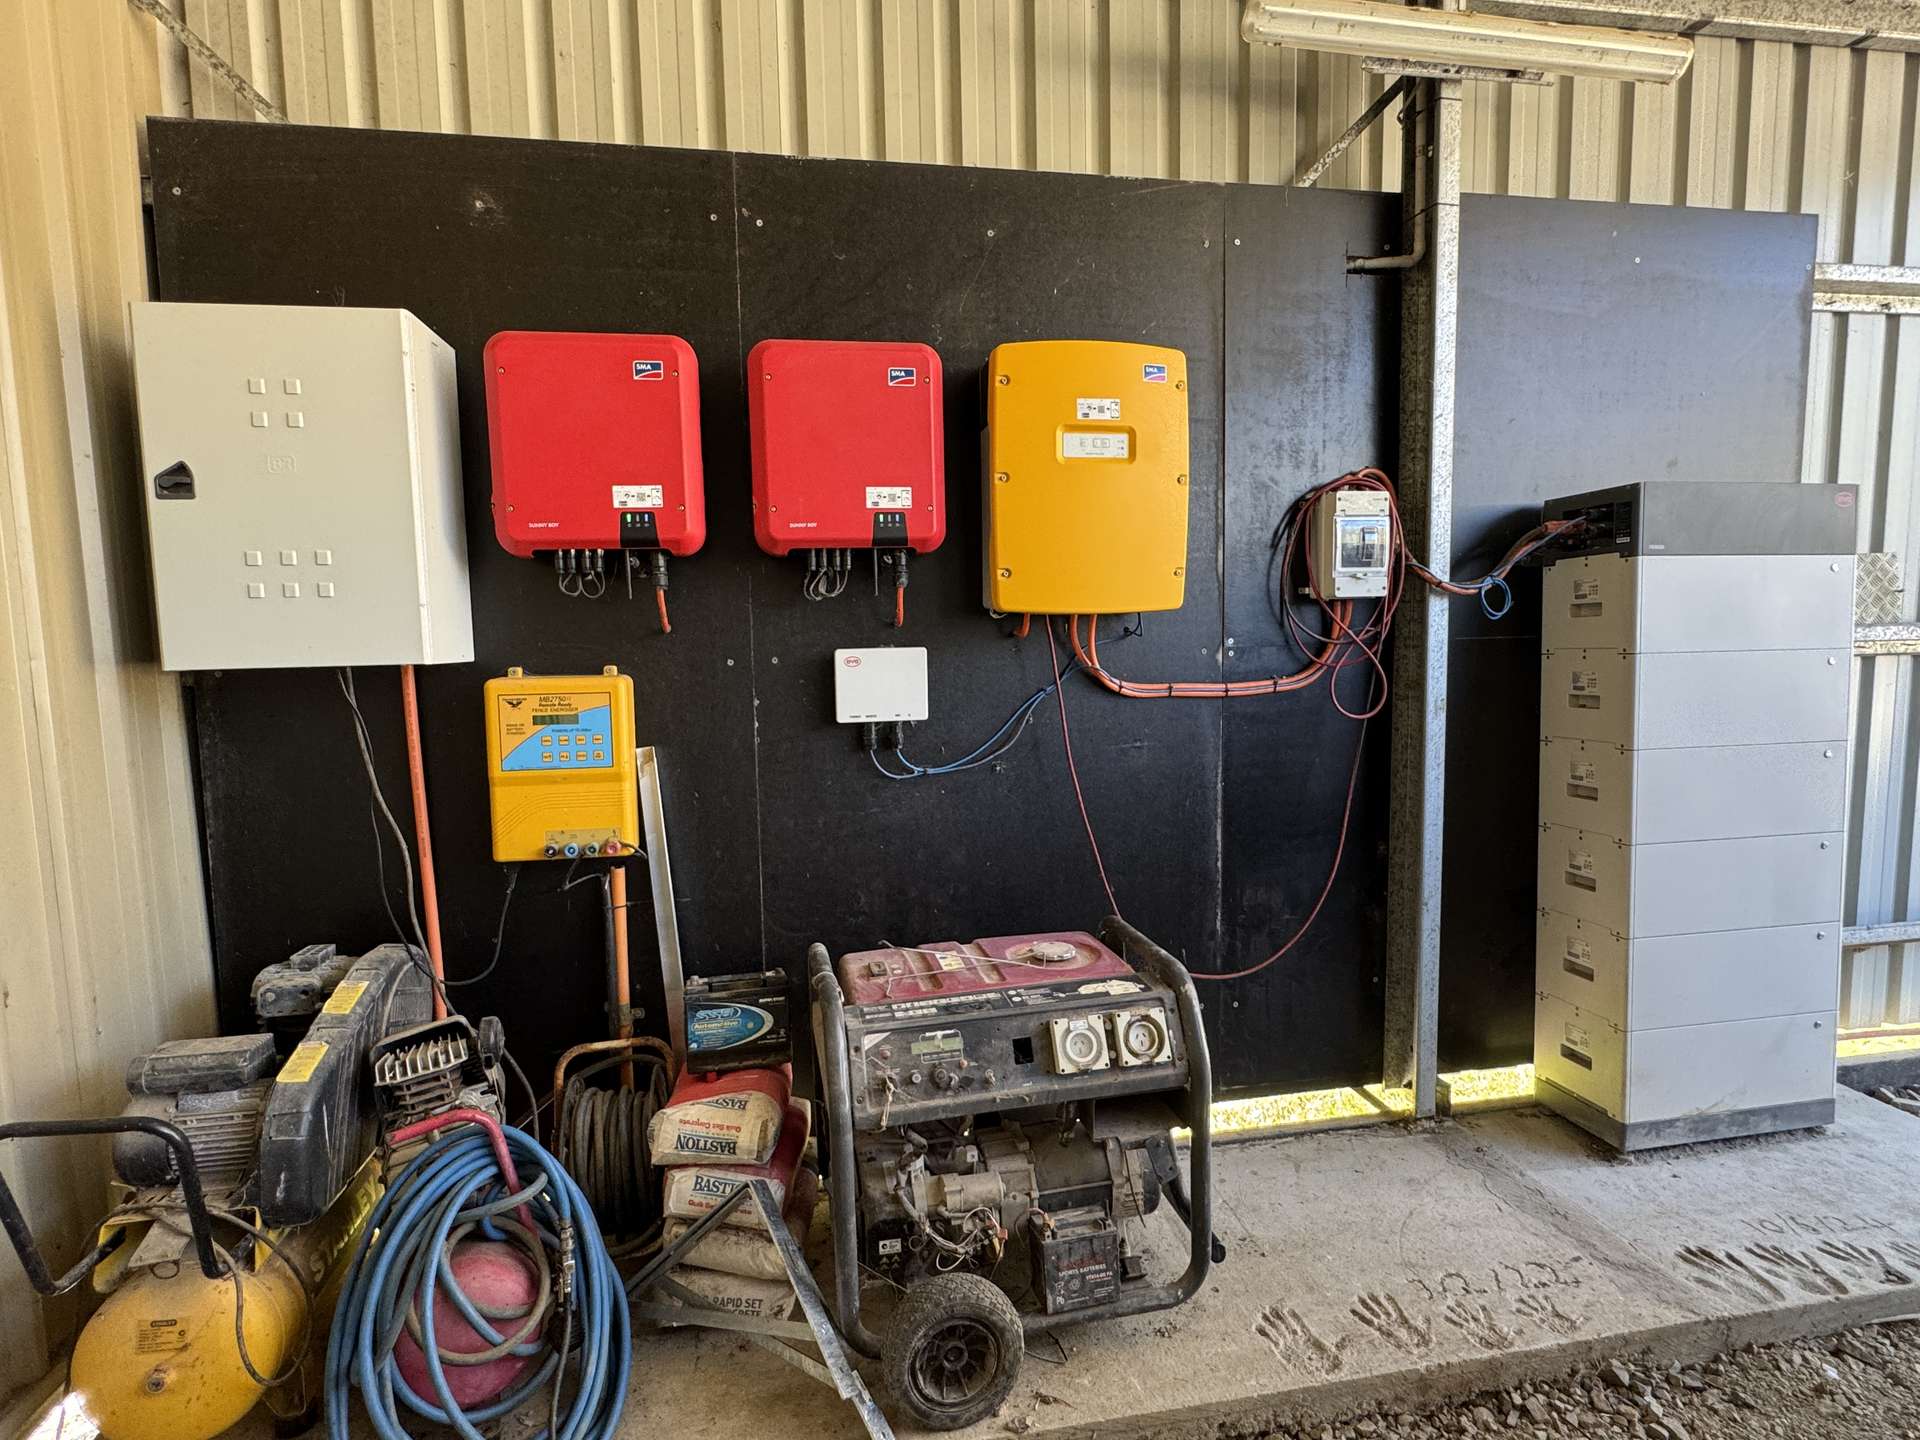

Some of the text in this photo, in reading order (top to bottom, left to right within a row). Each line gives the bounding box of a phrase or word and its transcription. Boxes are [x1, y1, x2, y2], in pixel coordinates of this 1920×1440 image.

[675, 1134, 738, 1155] BASTION
[692, 1175, 741, 1194] BASTI
[712, 1296, 764, 1309] RAPID SET
